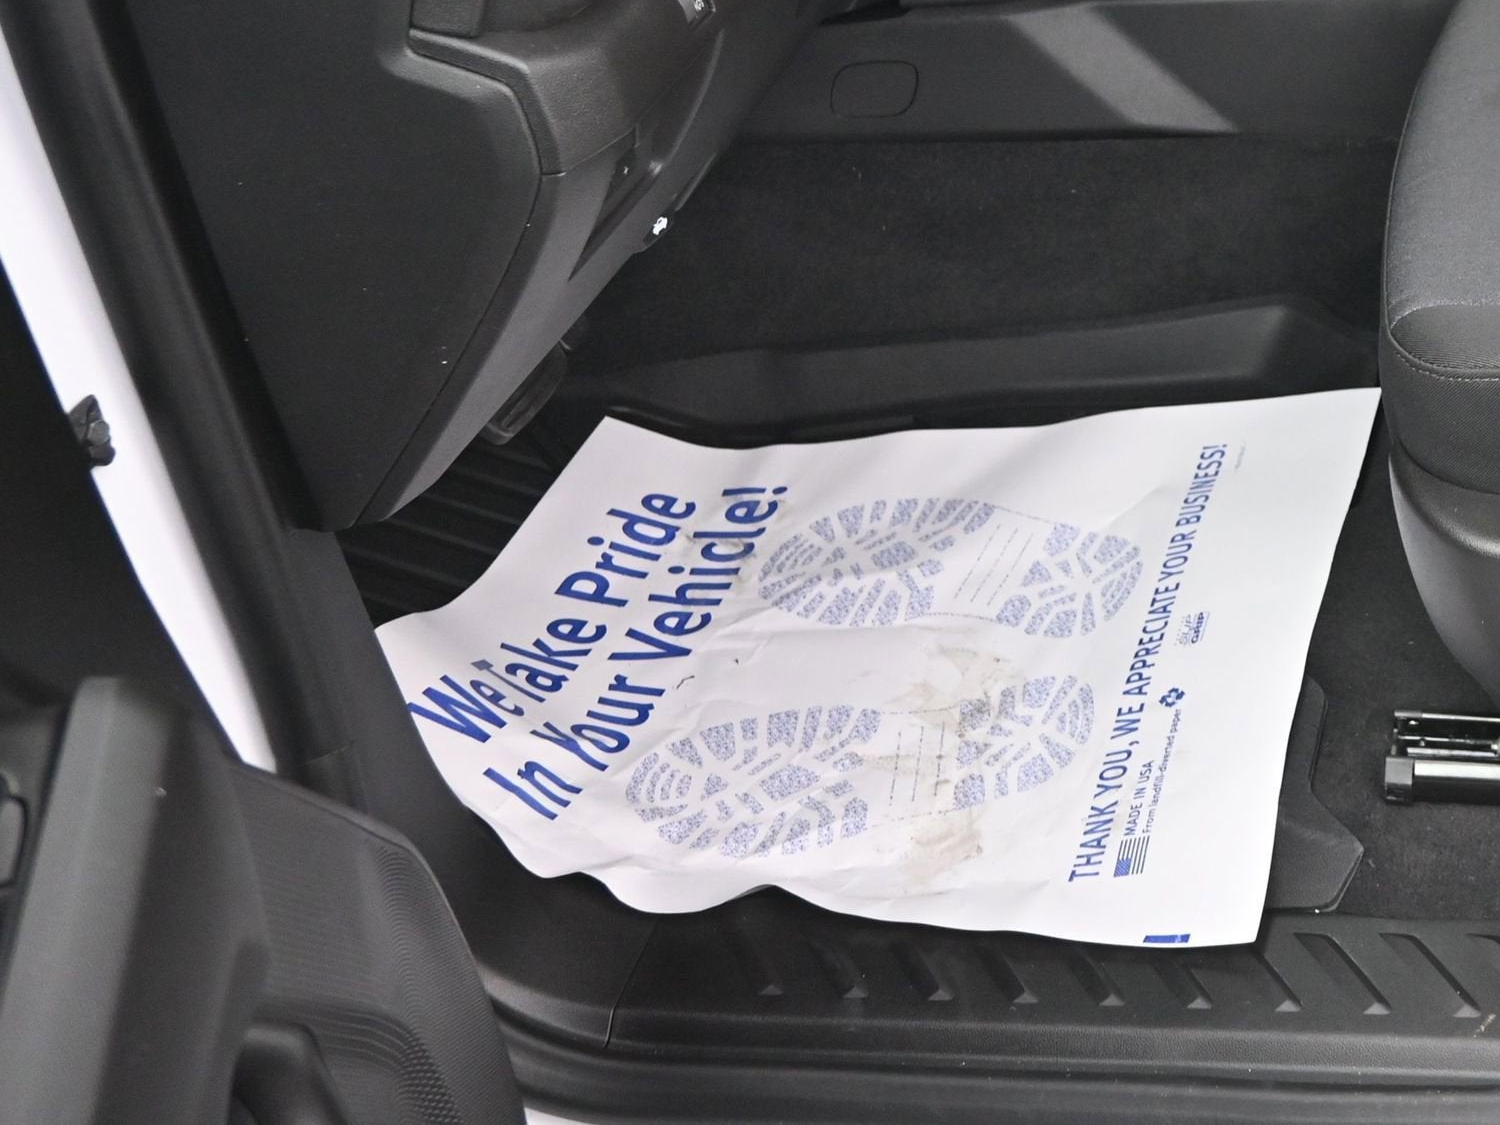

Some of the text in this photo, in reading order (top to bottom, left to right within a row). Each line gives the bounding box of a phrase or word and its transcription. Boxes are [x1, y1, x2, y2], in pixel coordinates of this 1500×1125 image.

[406, 493, 697, 743] We Take Pride
[483, 486, 788, 820] In Your Vehicle!
[1068, 443, 1228, 882] THANK YOU, WE APPRECIATE YOUR BUSINESS!
[1190, 612, 1204, 644] GRIP
[1123, 760, 1154, 836] MADE IN USA
[1142, 709, 1182, 834] From landfill-diverted paper
